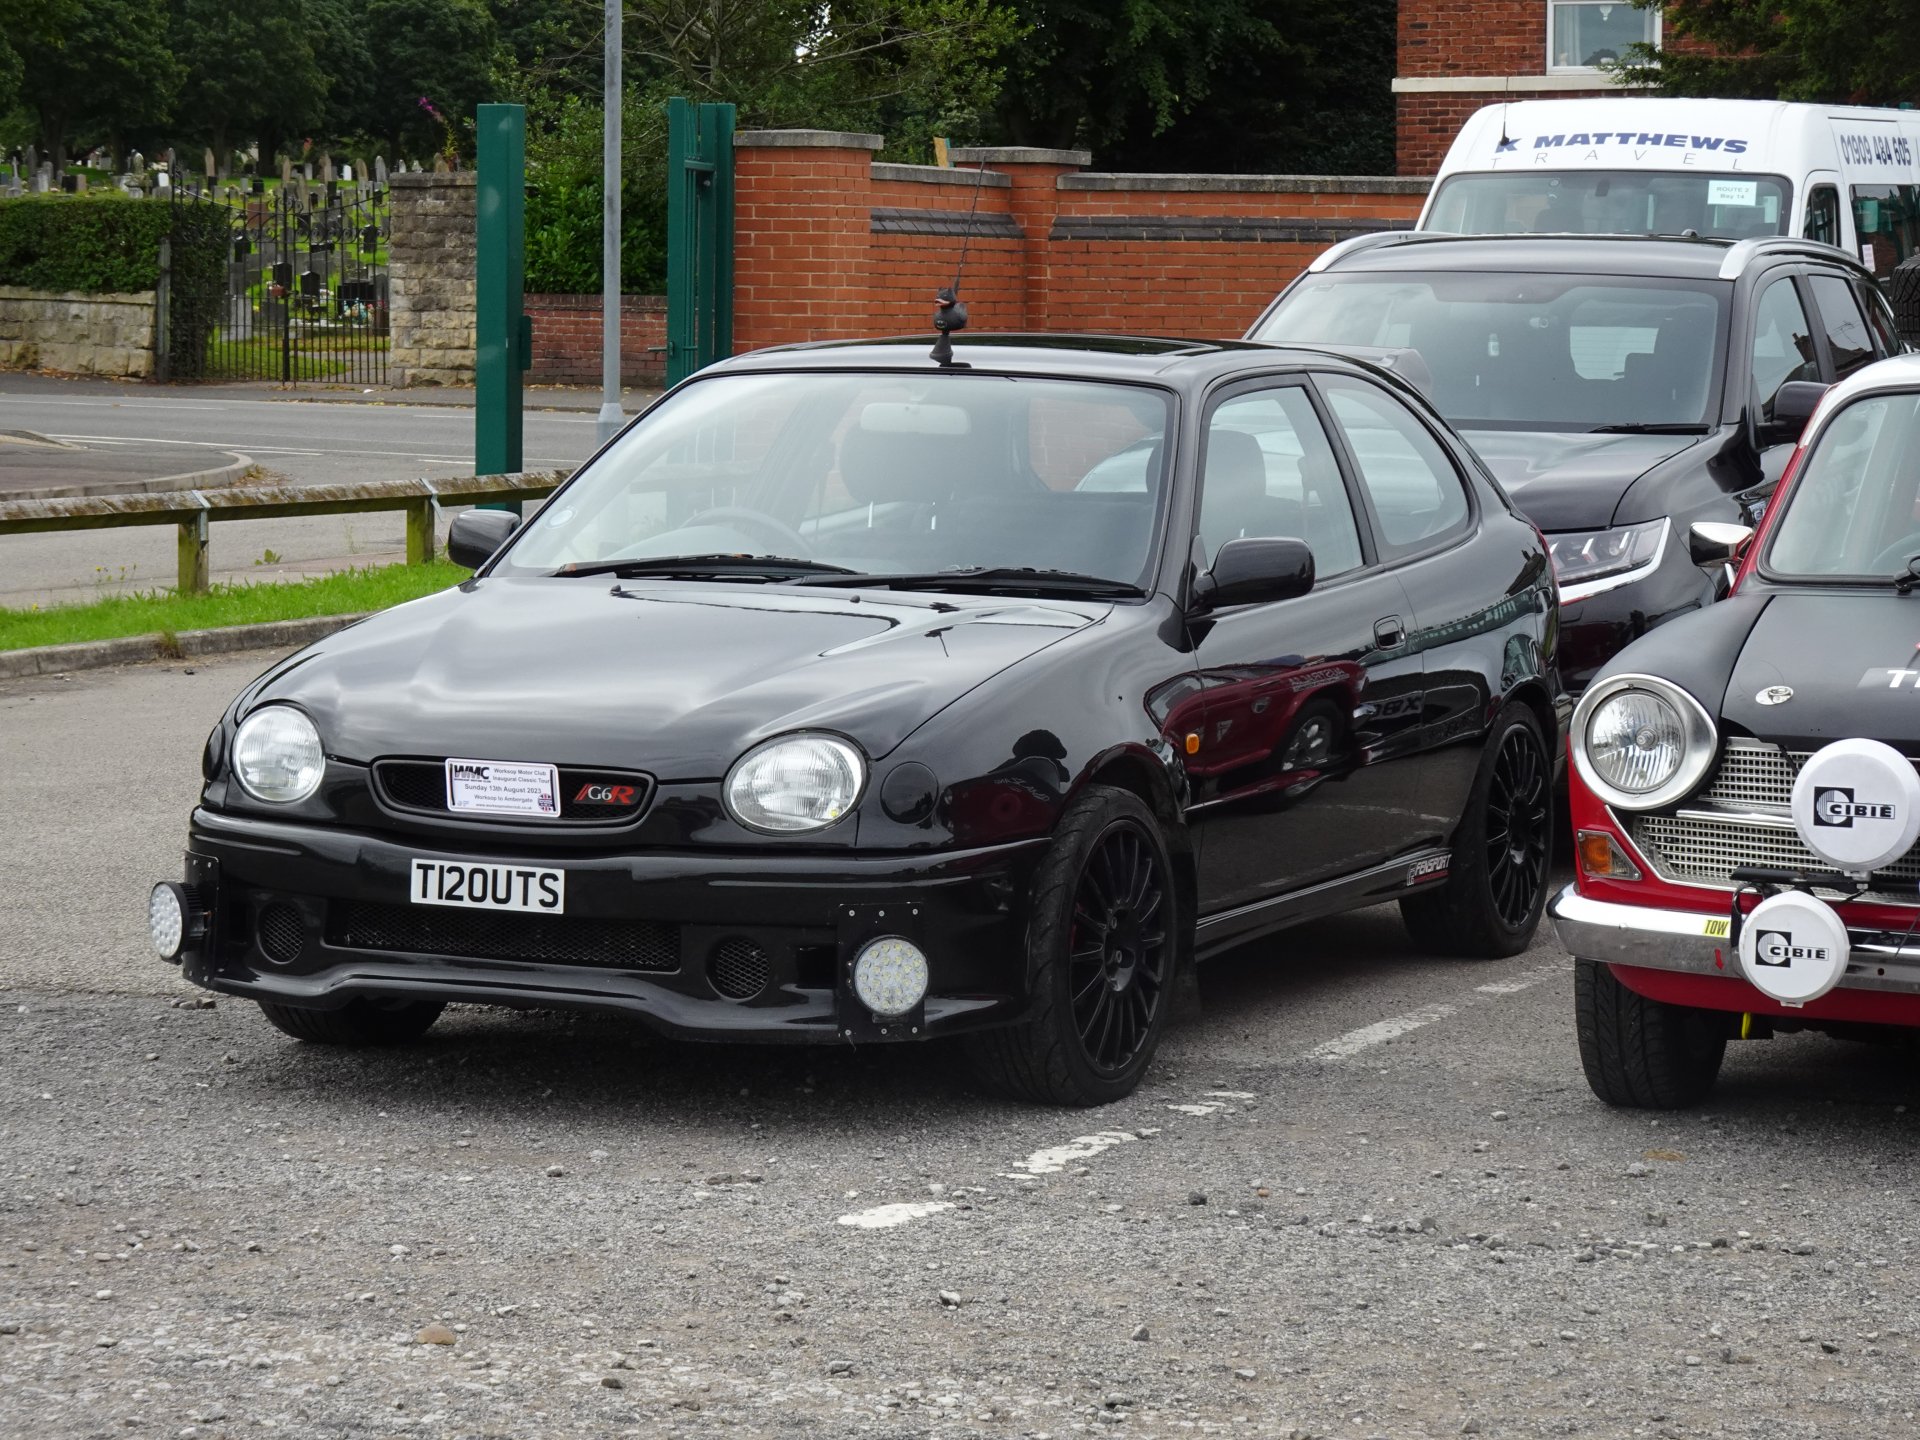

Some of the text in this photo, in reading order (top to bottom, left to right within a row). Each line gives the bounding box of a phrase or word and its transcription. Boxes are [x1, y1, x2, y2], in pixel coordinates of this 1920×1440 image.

[1533, 132, 1749, 154] MATTHEWS
[1840, 134, 1873, 166] 01909
[1873, 135, 1893, 166] 484
[1892, 136, 1912, 167] 605
[1490, 149, 1743, 171] TRAVEL
[454, 764, 490, 780] WMC
[493, 768, 517, 776] Worksop
[493, 775, 517, 783] Inaugural
[465, 783, 487, 792] Sunday
[489, 784, 502, 792] 13th
[503, 785, 526, 794] August
[1704, 919, 1729, 936] TOW
